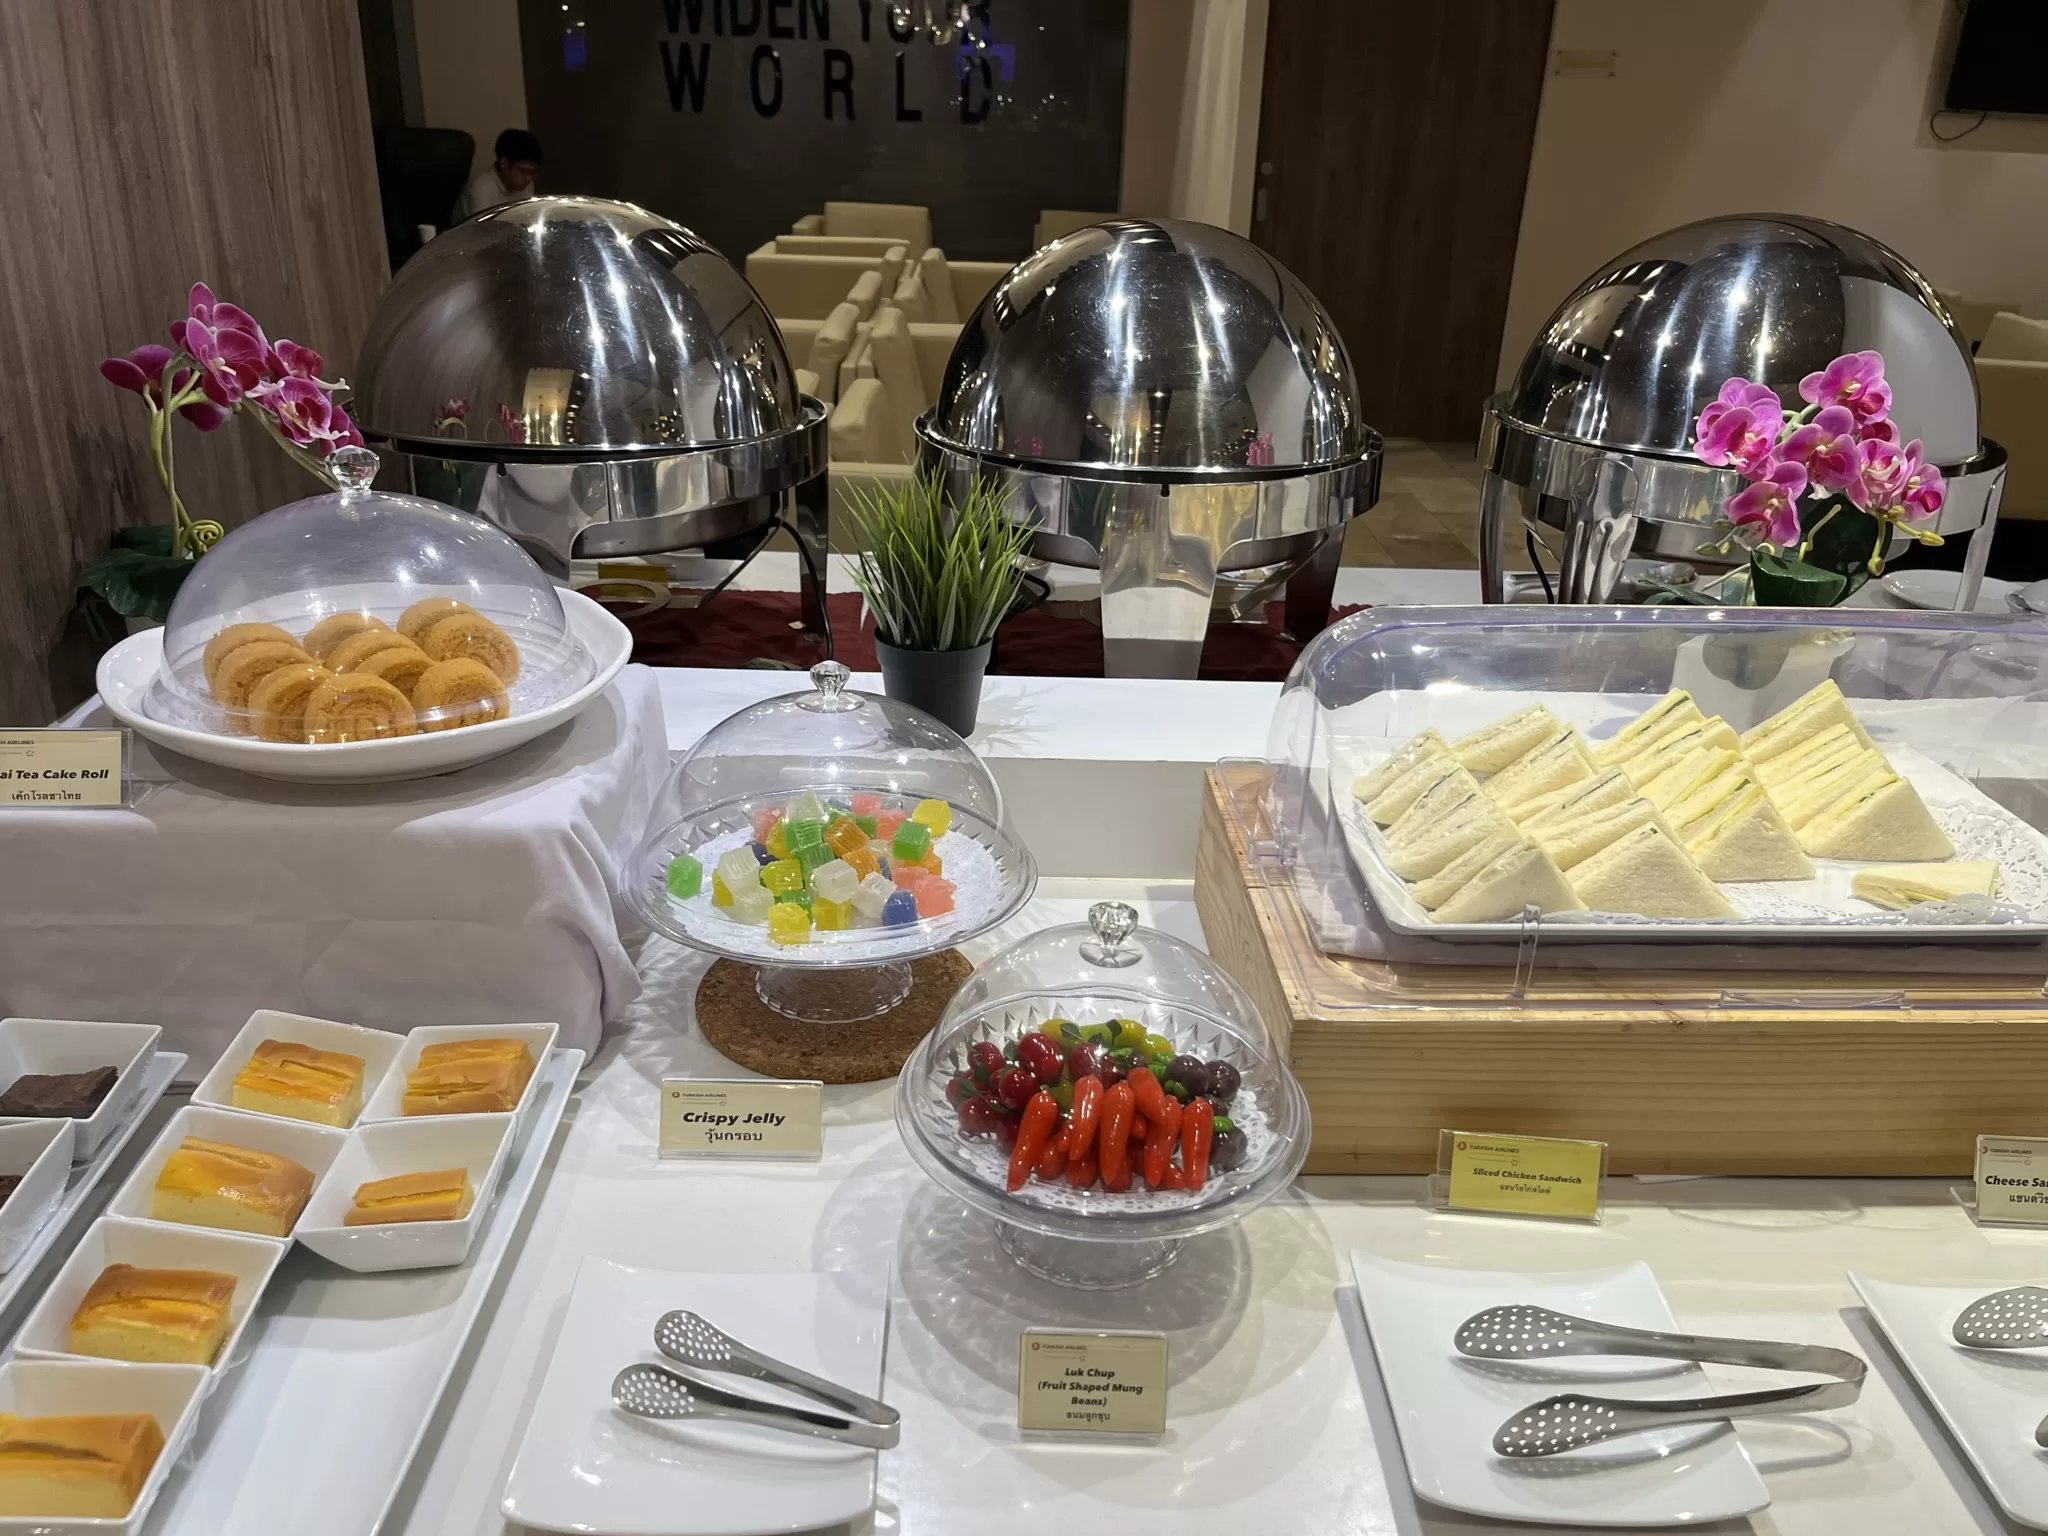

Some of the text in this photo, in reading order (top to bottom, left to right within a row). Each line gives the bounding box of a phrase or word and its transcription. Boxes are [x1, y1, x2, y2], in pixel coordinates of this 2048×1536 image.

[659, 41, 993, 124] WORLD
[16, 769, 39, 780] Tea
[43, 769, 78, 780] Cake
[81, 769, 109, 780] Roll
[683, 1112, 786, 1126] Crispy Jelly
[705, 1128, 763, 1144] วุ้นกรอบ
[1469, 1144, 1494, 1152] TURKISH
[1472, 1168, 1582, 1184] Sliced Chicken Sandwich
[1985, 1175, 2029, 1187] Cheese
[1065, 1367, 1115, 1379] Luk Chup
[1037, 1381, 1143, 1395] (Fruit Shaped Mung
[1071, 1397, 1107, 1407] Beans)
